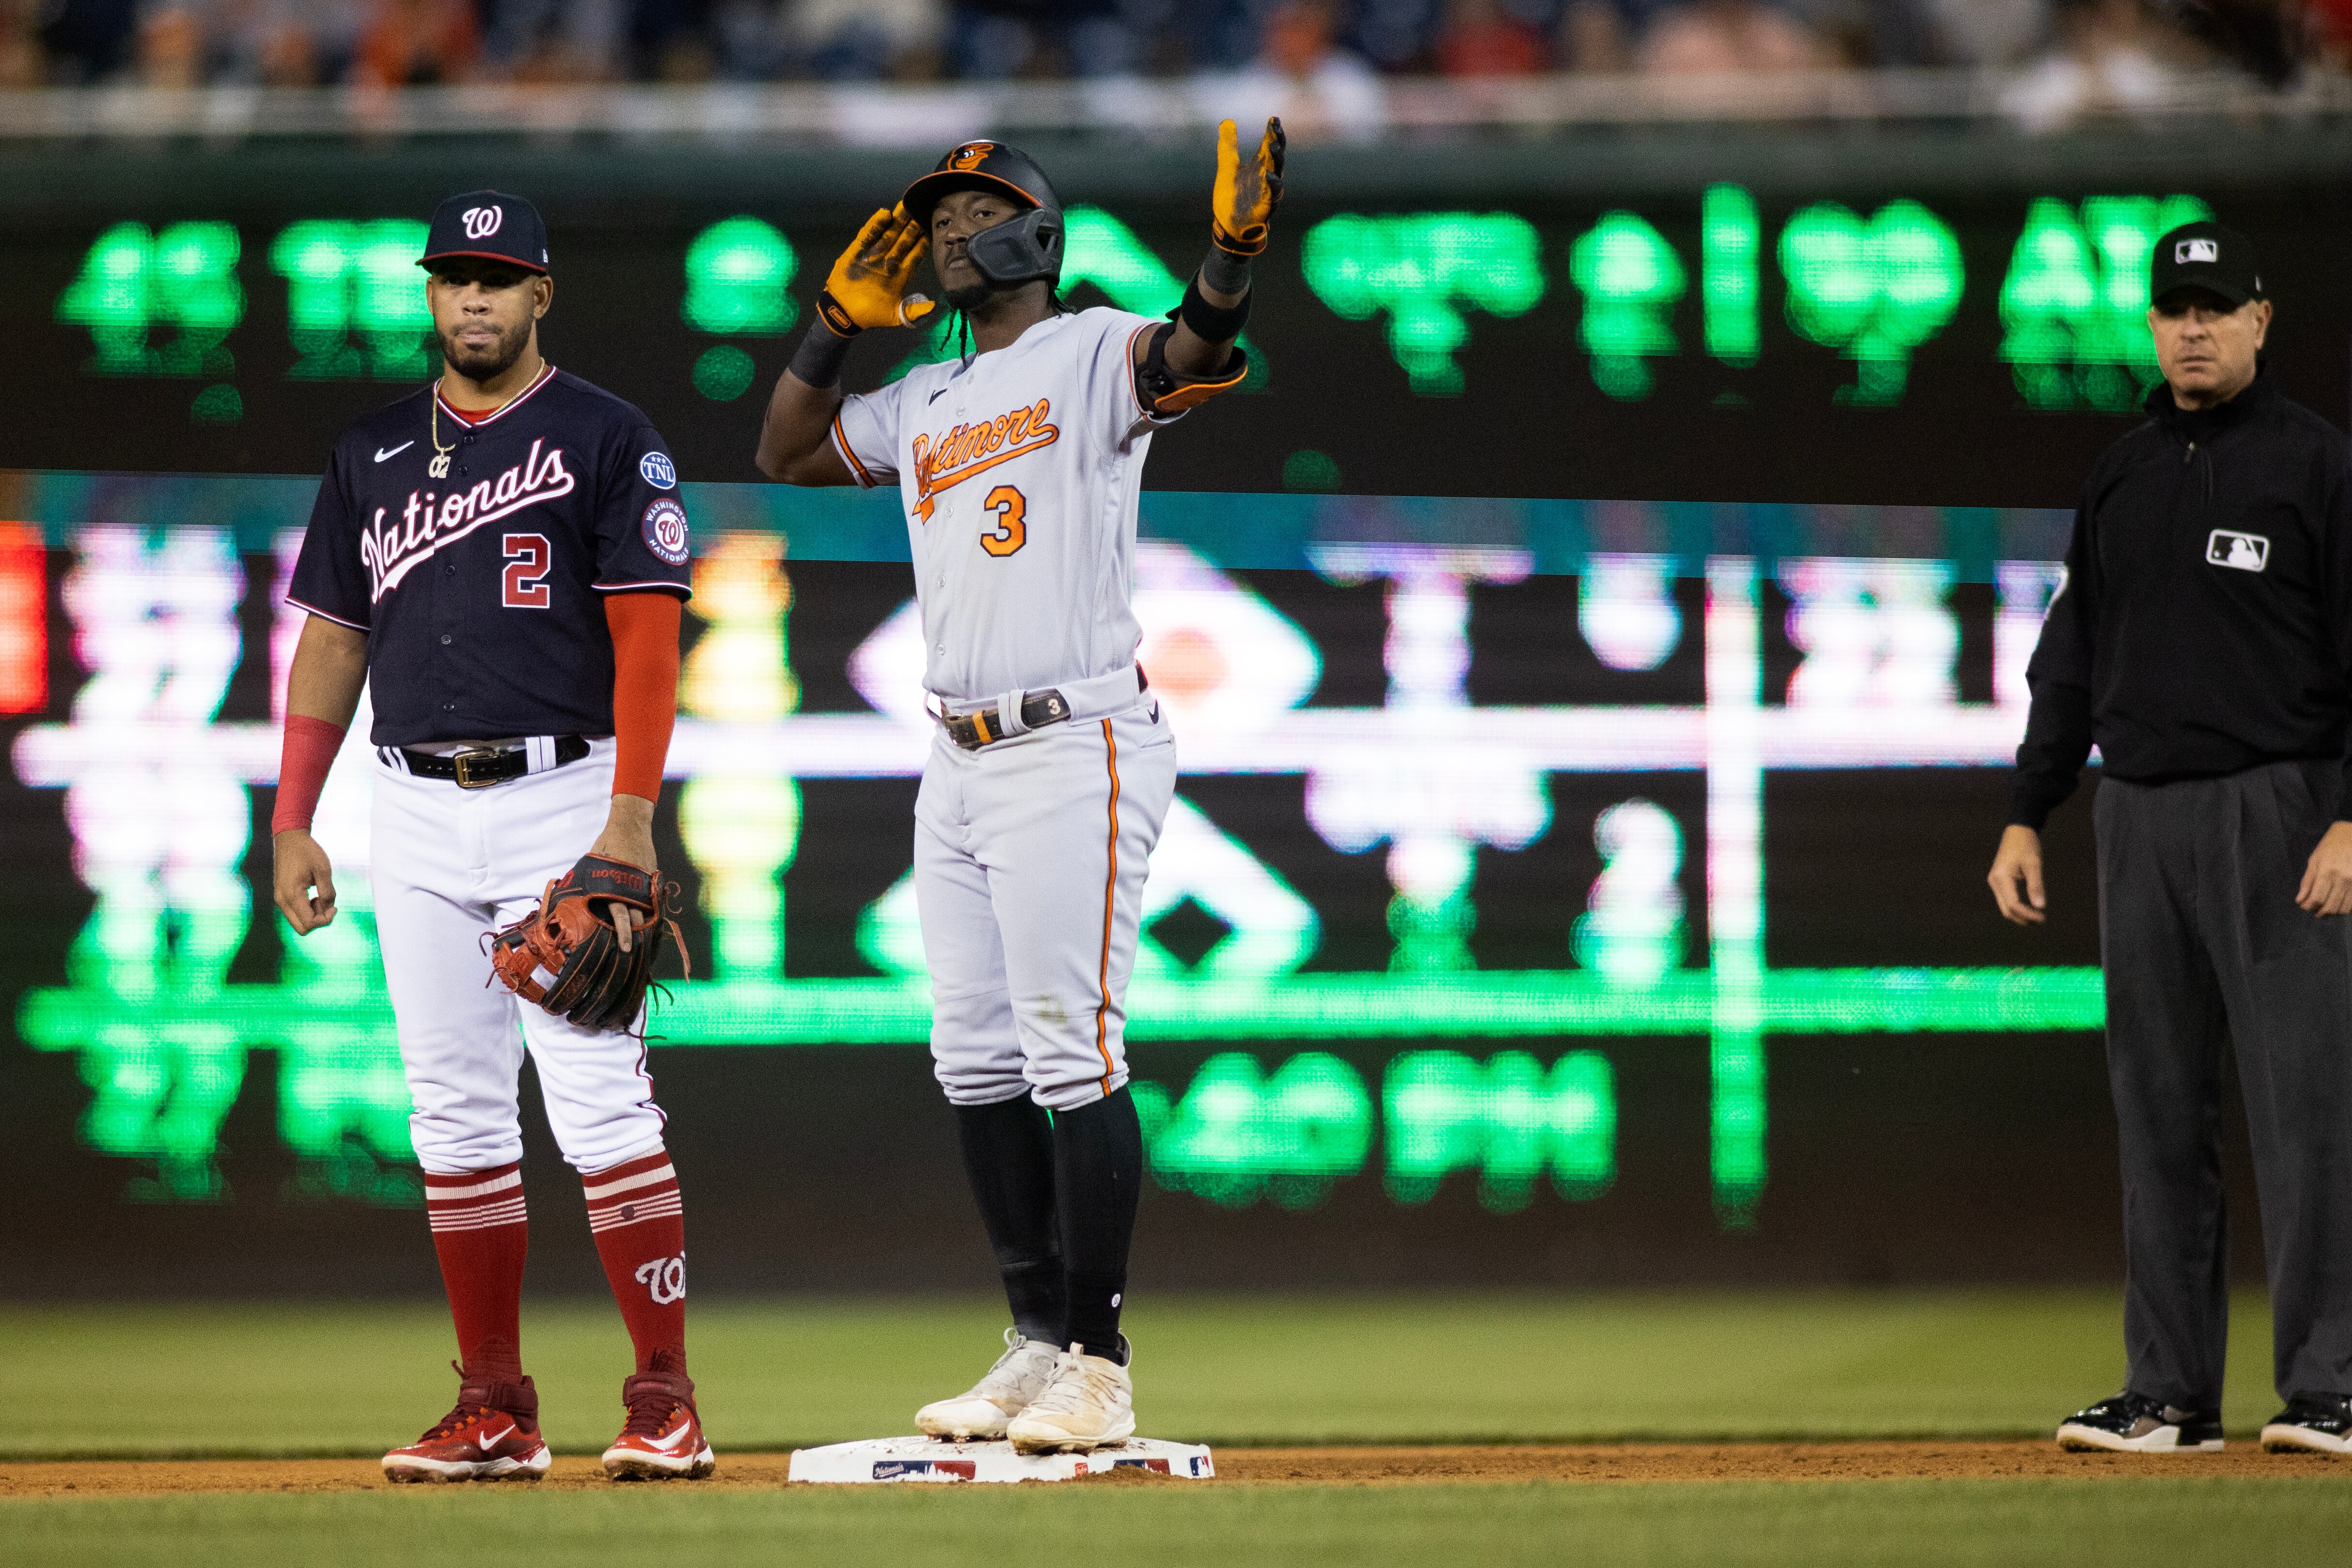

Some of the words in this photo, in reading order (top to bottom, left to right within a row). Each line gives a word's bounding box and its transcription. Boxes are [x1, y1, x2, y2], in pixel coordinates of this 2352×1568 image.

[462, 205, 502, 239] W
[428, 455, 451, 479] 02
[644, 461, 675, 483] TNL
[361, 437, 575, 604] Nationals
[646, 501, 689, 532] WASHINGTON
[980, 485, 1027, 558] 3
[658, 519, 680, 546] W
[649, 539, 689, 562] NATIONALS
[503, 533, 551, 608] 2
[1047, 698, 1061, 715] 3
